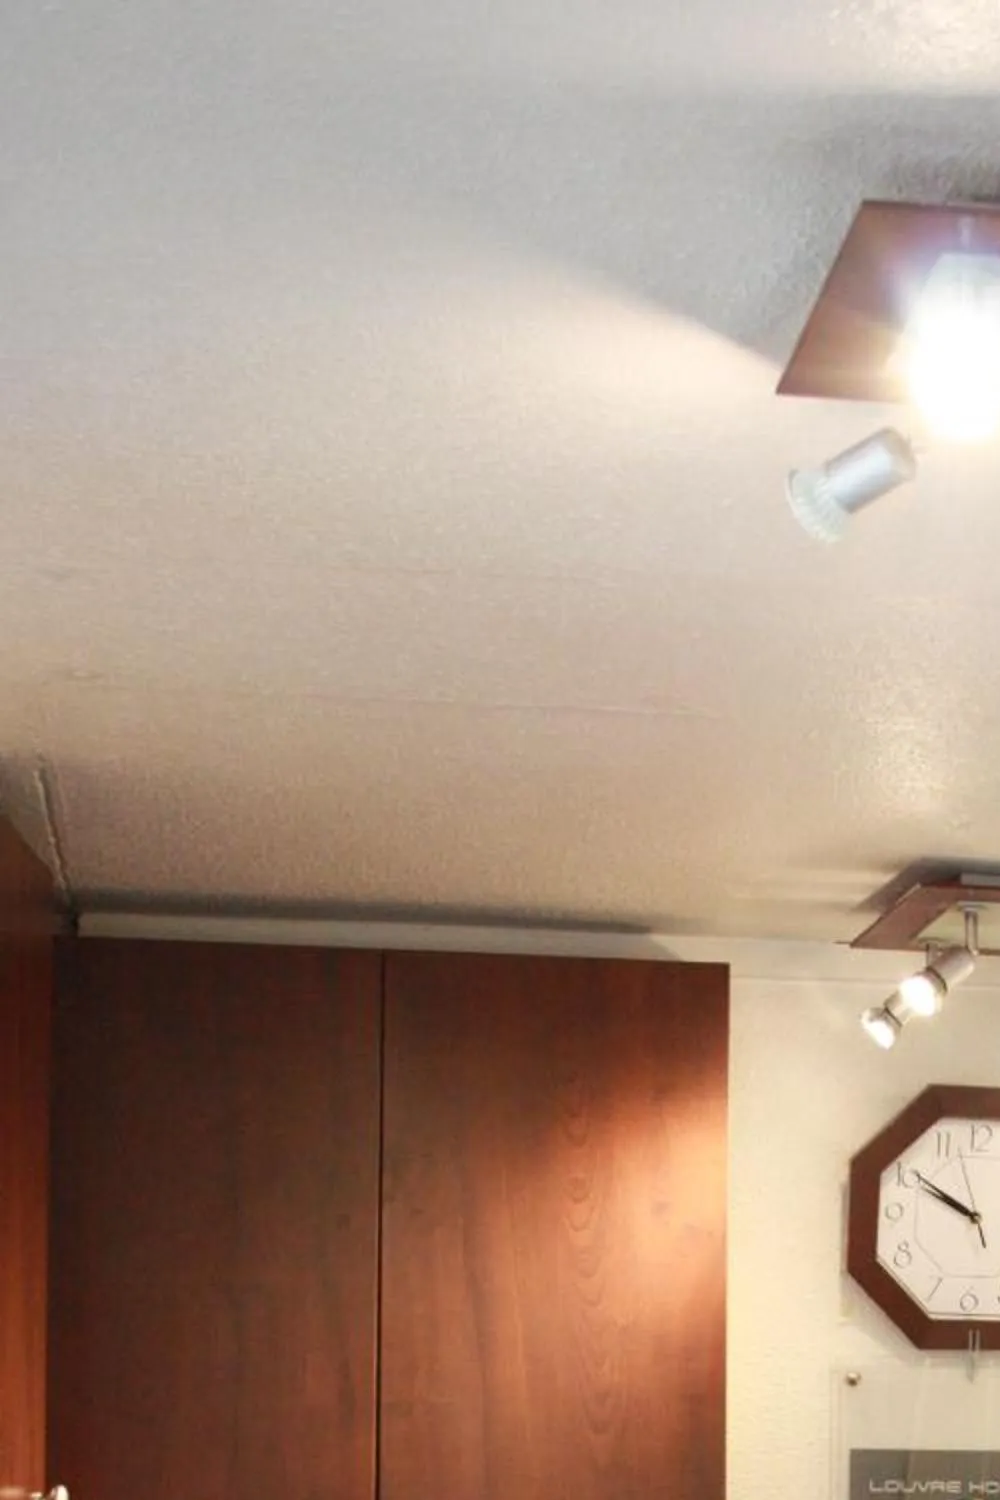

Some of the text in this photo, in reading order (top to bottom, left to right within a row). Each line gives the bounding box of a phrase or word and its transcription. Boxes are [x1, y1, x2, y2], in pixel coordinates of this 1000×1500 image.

[936, 1131, 951, 1158] 11
[970, 1123, 993, 1152] 12
[896, 1161, 921, 1189] 10
[893, 1241, 912, 1268] 8
[927, 1276, 943, 1302] 7
[959, 1286, 979, 1312] 6
[869, 1479, 964, 1494] LOUVRE
